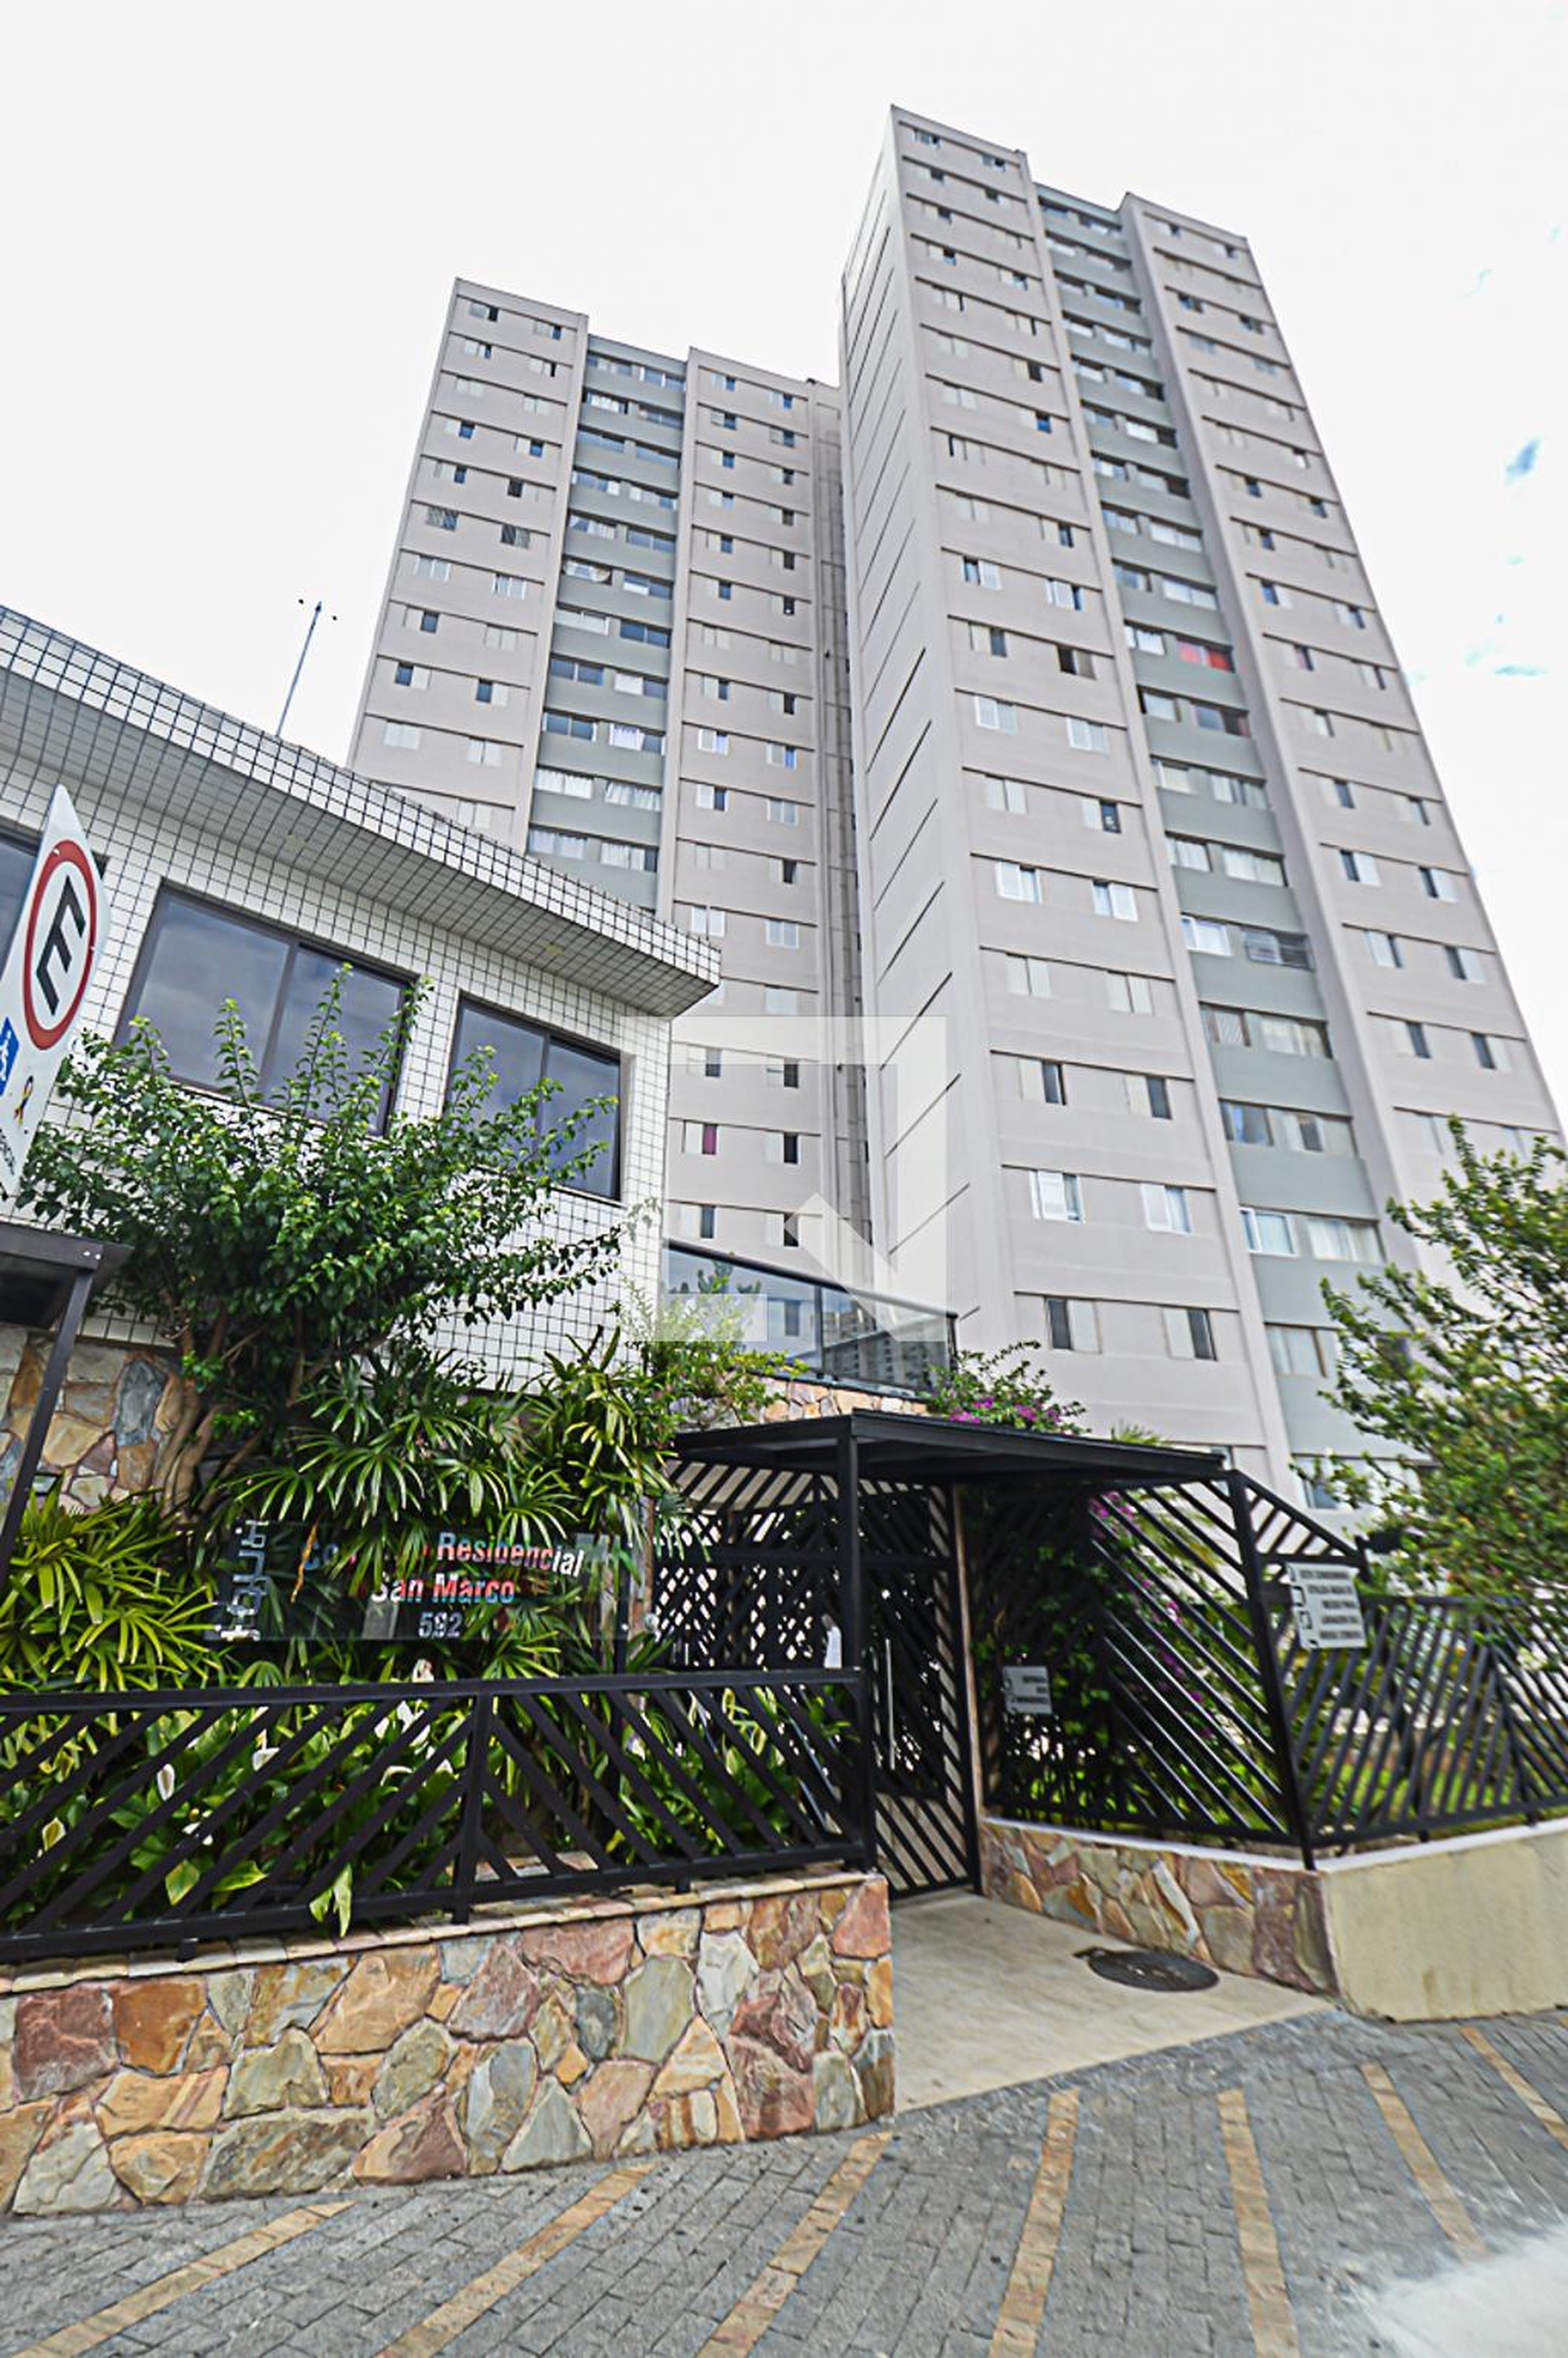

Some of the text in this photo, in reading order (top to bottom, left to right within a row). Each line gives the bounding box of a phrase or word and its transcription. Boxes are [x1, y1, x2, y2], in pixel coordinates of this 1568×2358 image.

[37, 875, 86, 1016] E
[437, 1532, 584, 1577] Residencial
[433, 1573, 515, 1603] Marco
